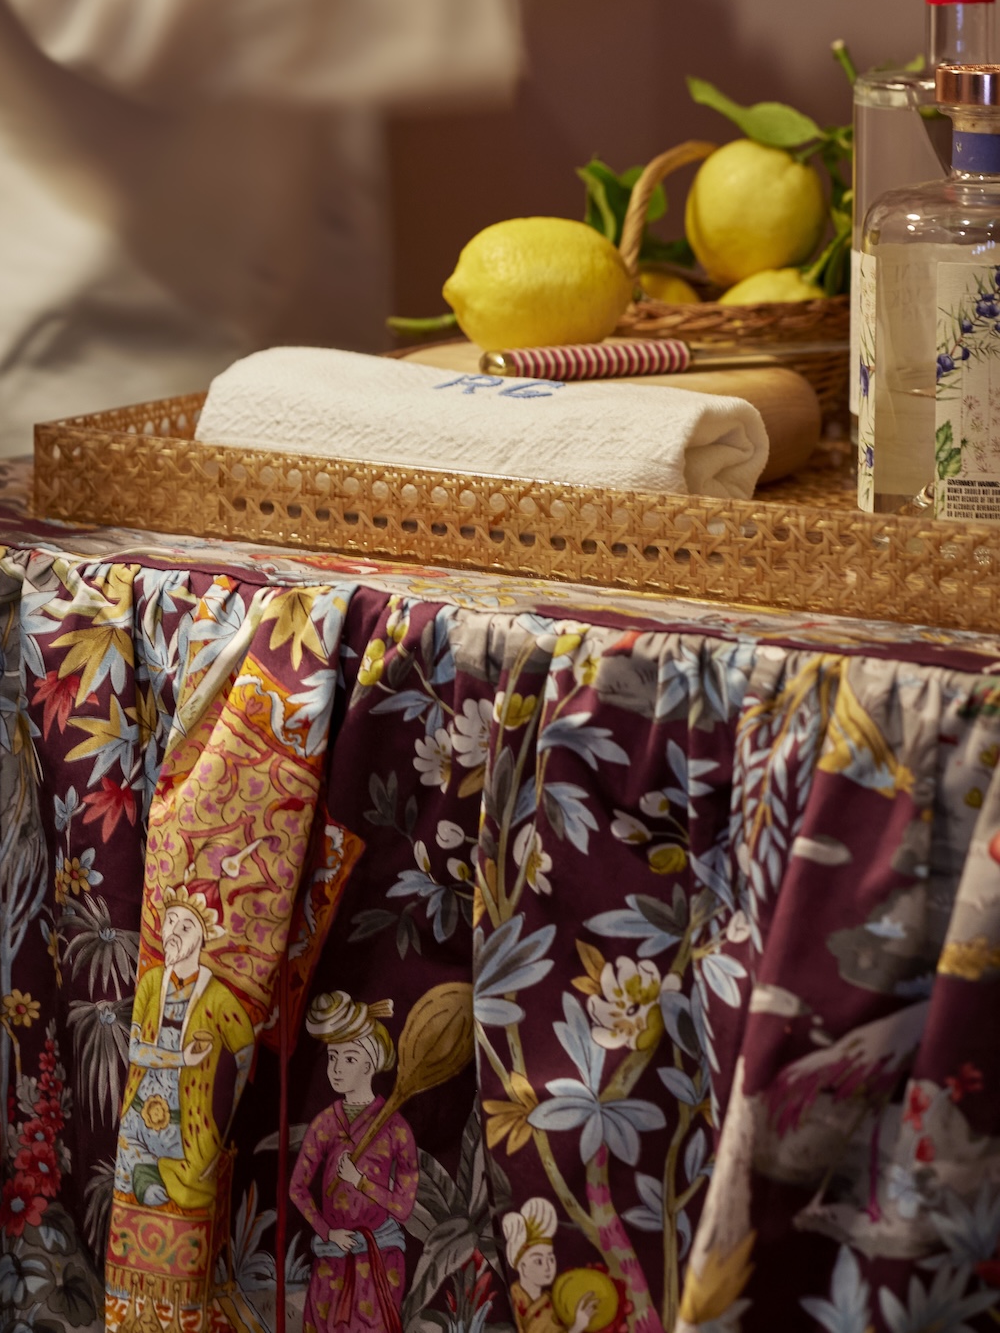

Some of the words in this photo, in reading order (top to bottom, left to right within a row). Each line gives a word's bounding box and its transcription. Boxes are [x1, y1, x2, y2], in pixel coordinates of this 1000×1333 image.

[947, 478, 976, 487] GOVERNMENT
[964, 487, 981, 495] SHOULD
[961, 495, 979, 503] BECAUSE
